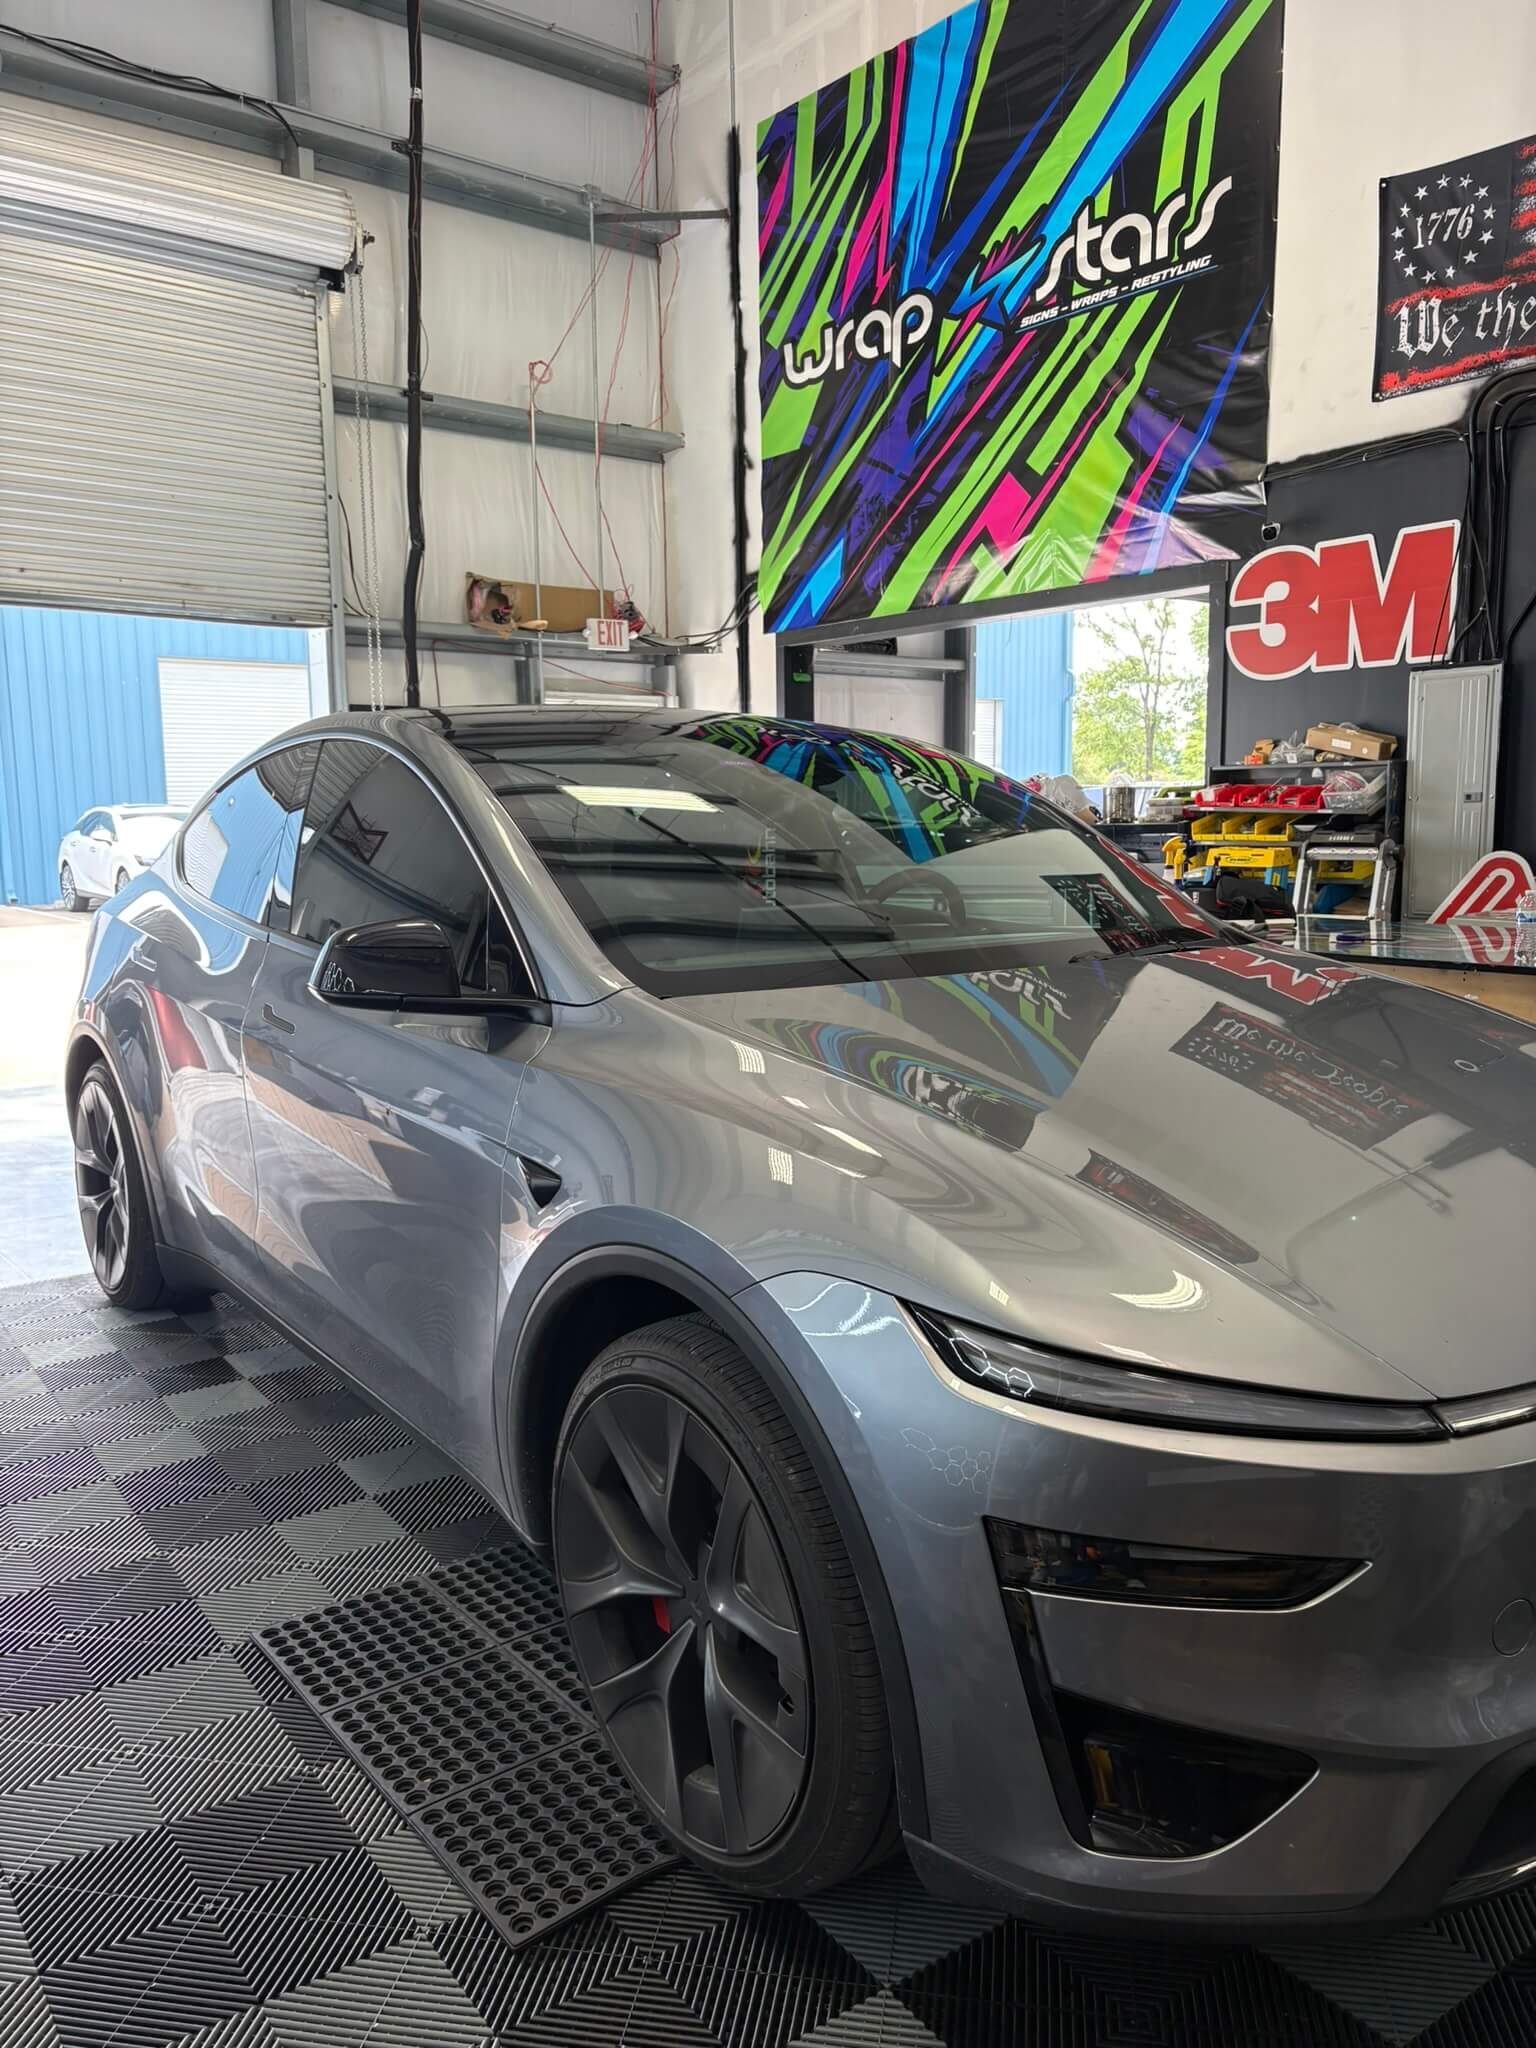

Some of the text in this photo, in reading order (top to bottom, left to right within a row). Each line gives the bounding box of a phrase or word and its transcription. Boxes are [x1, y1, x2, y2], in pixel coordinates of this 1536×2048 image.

[1413, 203, 1475, 250] 1776
[784, 176, 1232, 384] wrap stars
[1020, 305, 1060, 328] SIGNS
[1070, 285, 1119, 311] WRAPS
[1131, 254, 1212, 290] RESTYLING
[1393, 297, 1465, 360] We
[597, 620, 624, 647] EXIT
[1226, 519, 1461, 681] 3M
